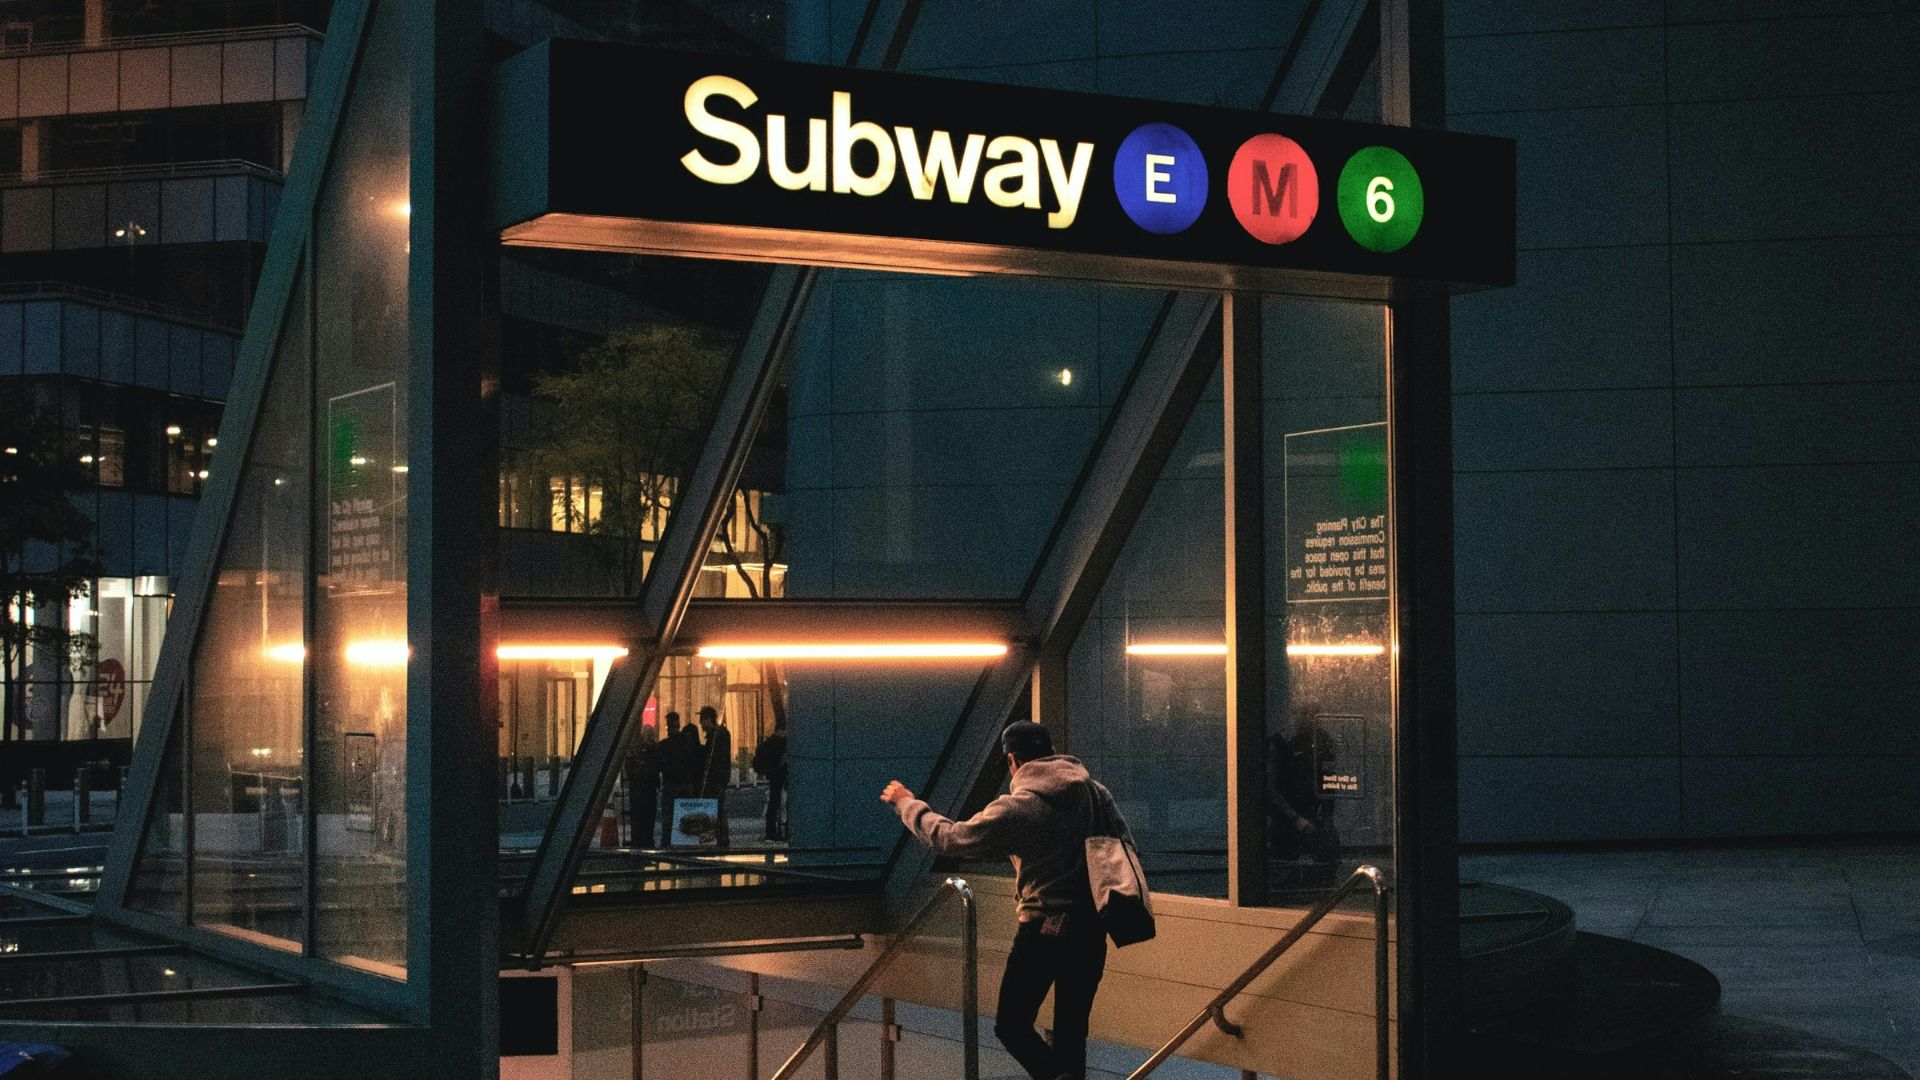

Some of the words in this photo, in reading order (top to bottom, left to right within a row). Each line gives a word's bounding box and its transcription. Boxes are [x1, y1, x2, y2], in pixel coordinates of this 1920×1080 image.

[680, 74, 1095, 229] Subway
[1146, 153, 1176, 203] E
[1252, 159, 1298, 218] M
[1366, 175, 1396, 224] 6
